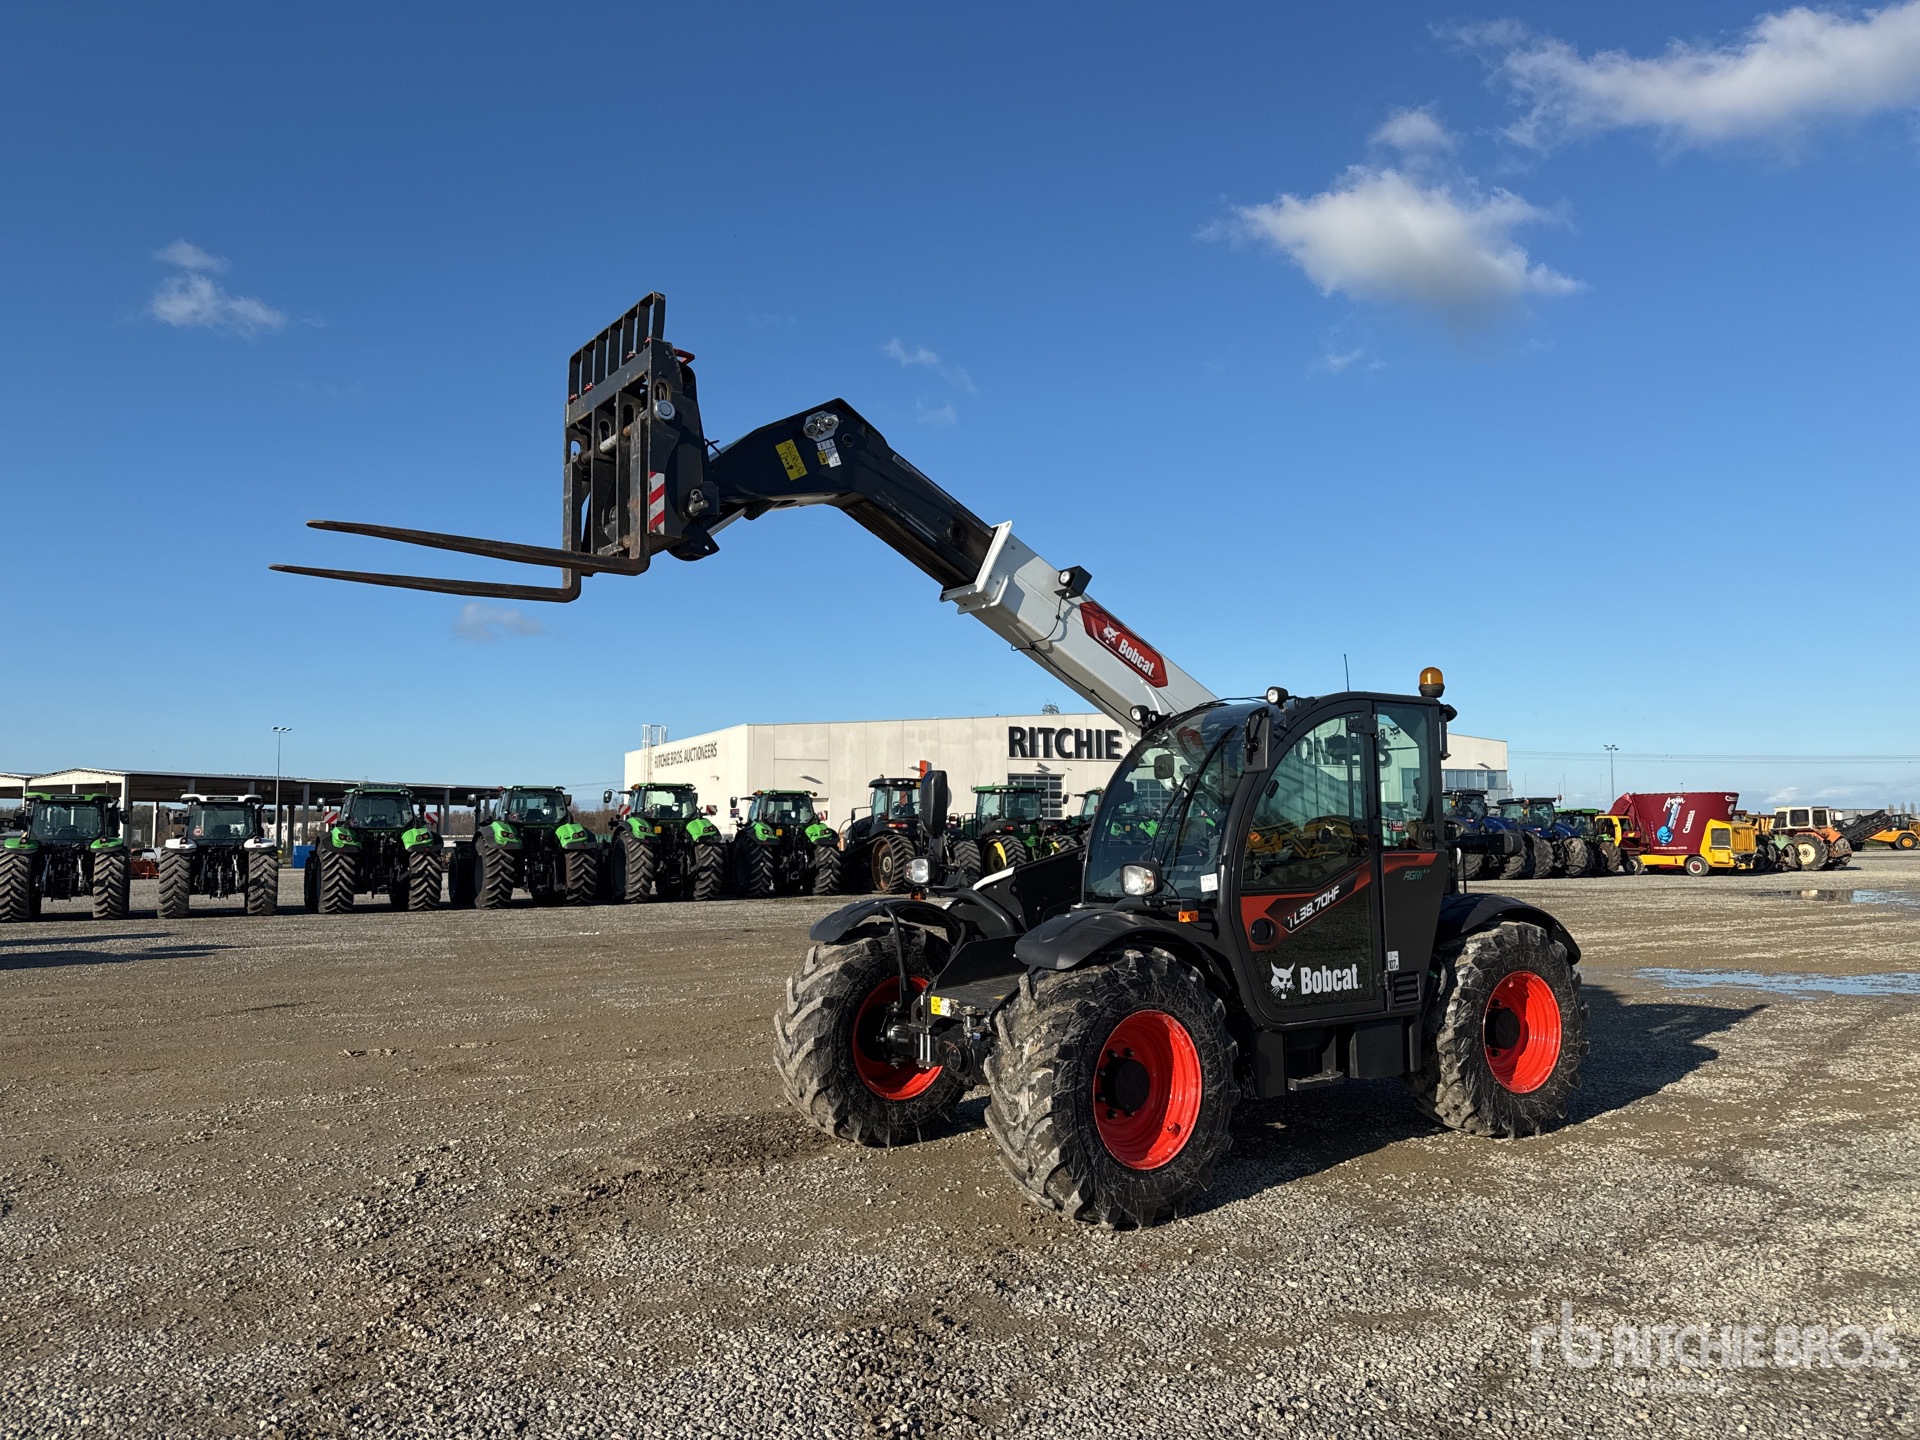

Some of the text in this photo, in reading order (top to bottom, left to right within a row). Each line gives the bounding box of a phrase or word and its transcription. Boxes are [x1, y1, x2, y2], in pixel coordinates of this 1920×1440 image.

[1118, 638, 1155, 677] Bobcat
[655, 753, 670, 768] RITCHIE
[684, 742, 718, 763] AUCTIONEERS
[1008, 726, 1123, 759] RITCHIE
[1300, 963, 1359, 995] Bobcat
